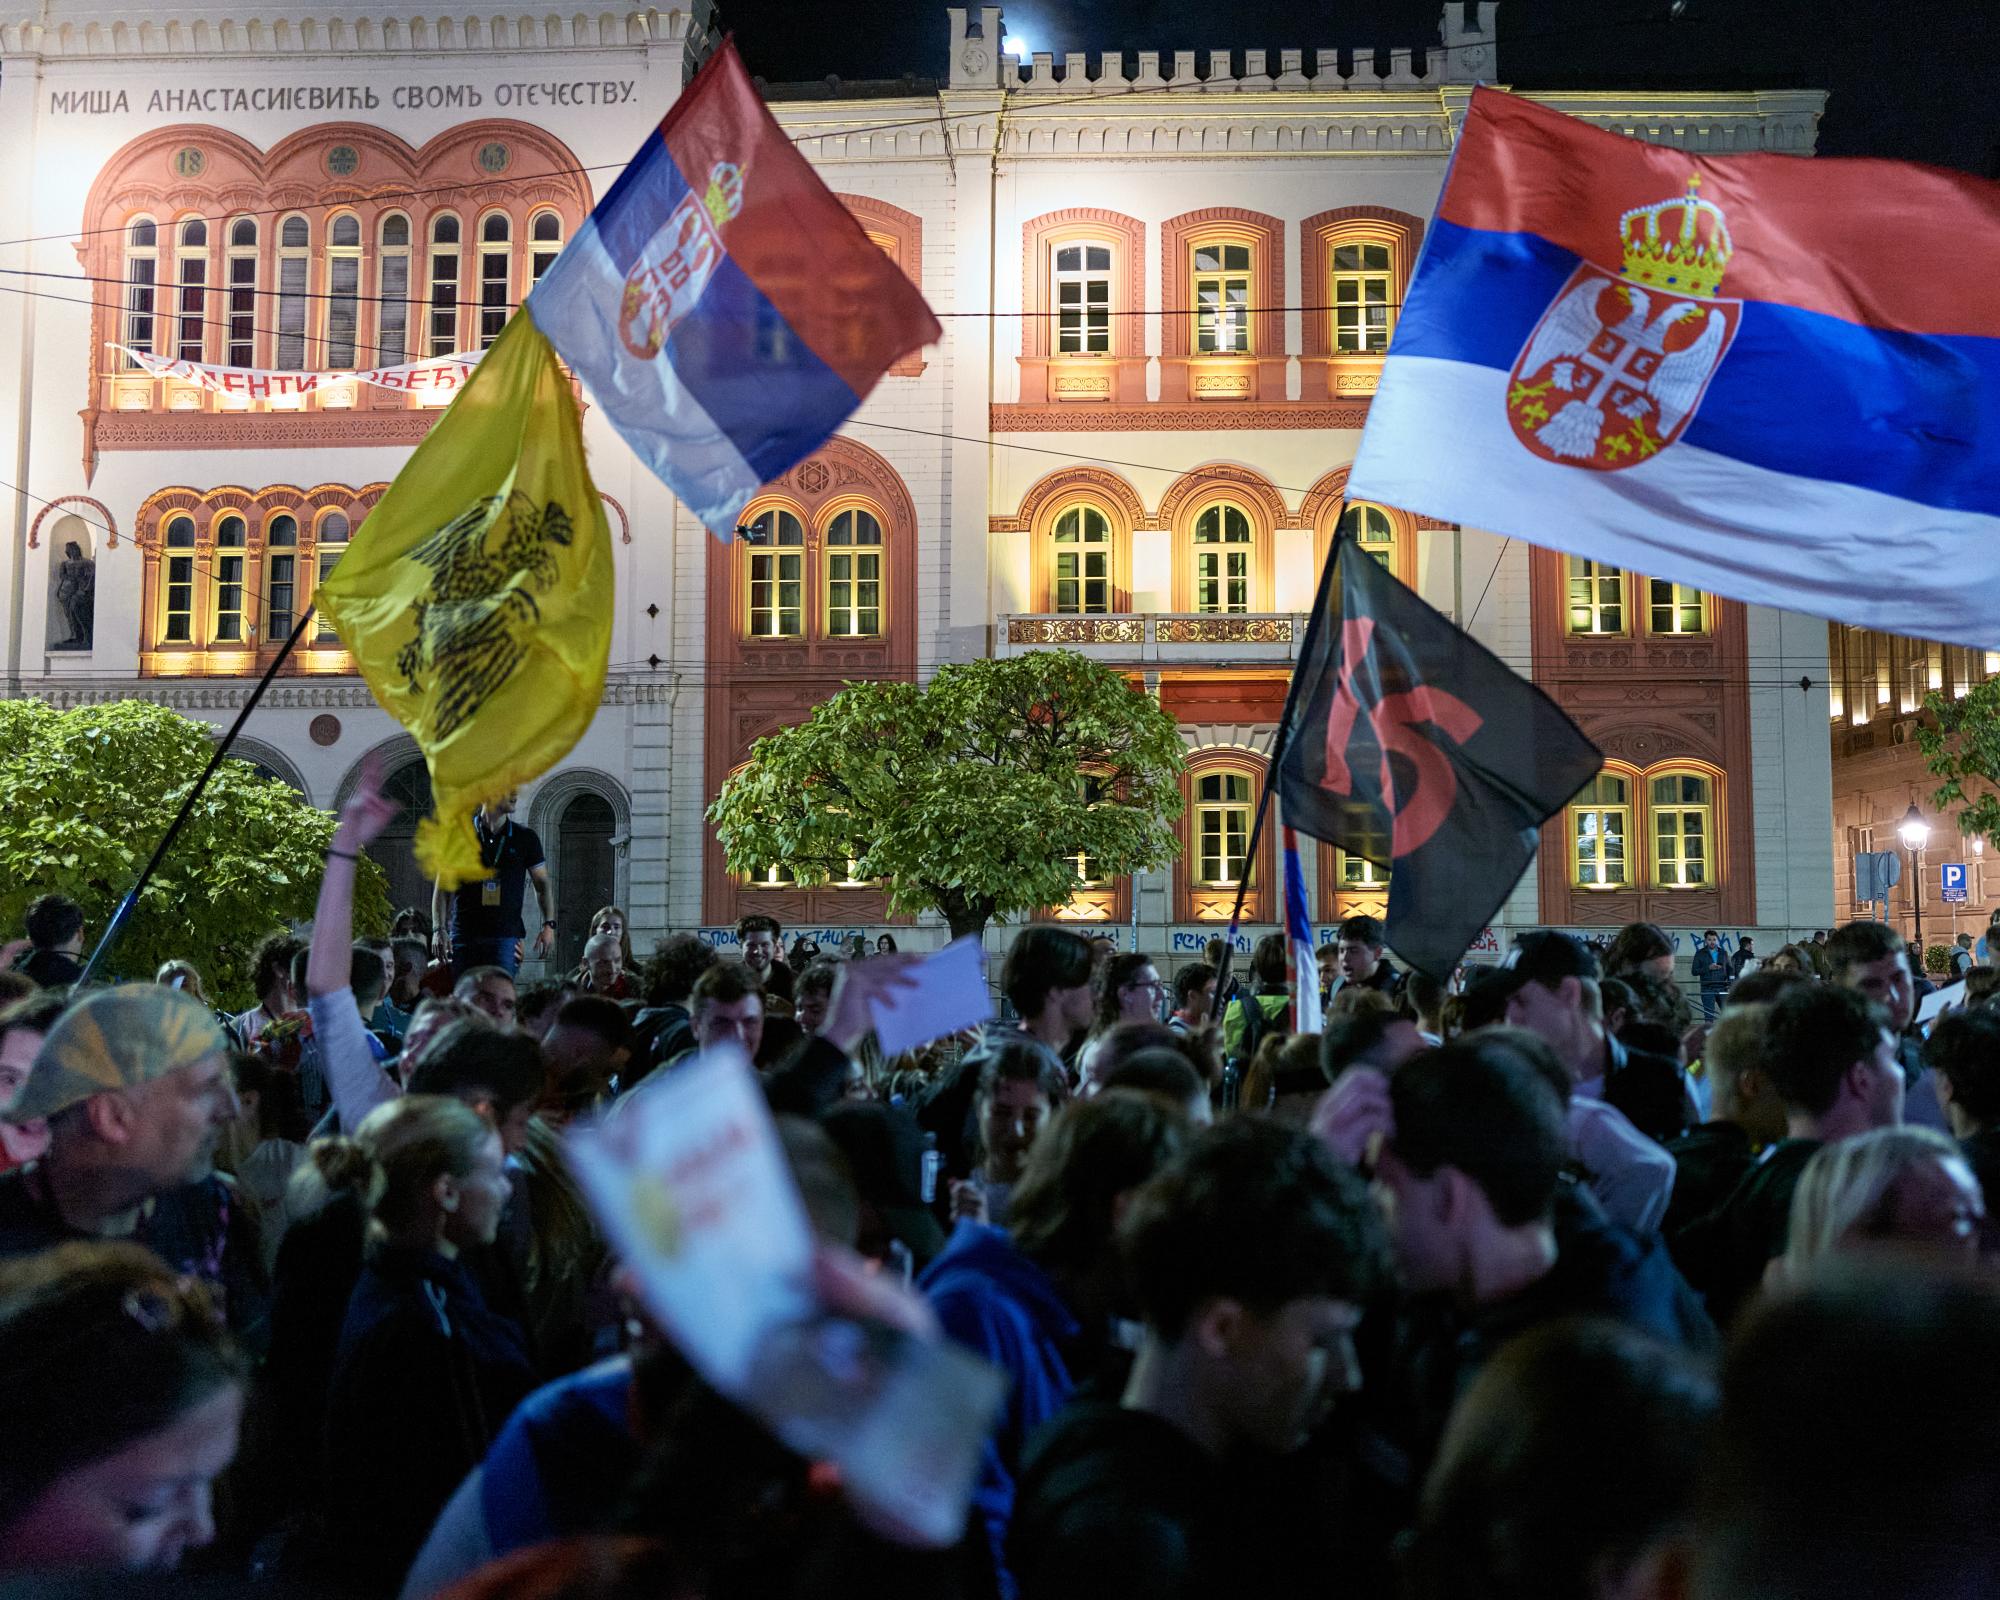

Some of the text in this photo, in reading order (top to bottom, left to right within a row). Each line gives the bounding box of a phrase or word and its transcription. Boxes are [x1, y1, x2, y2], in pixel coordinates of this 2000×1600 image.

[50, 90, 130, 115] МИША
[179, 148, 201, 173] 18
[1947, 866, 1961, 887] P
